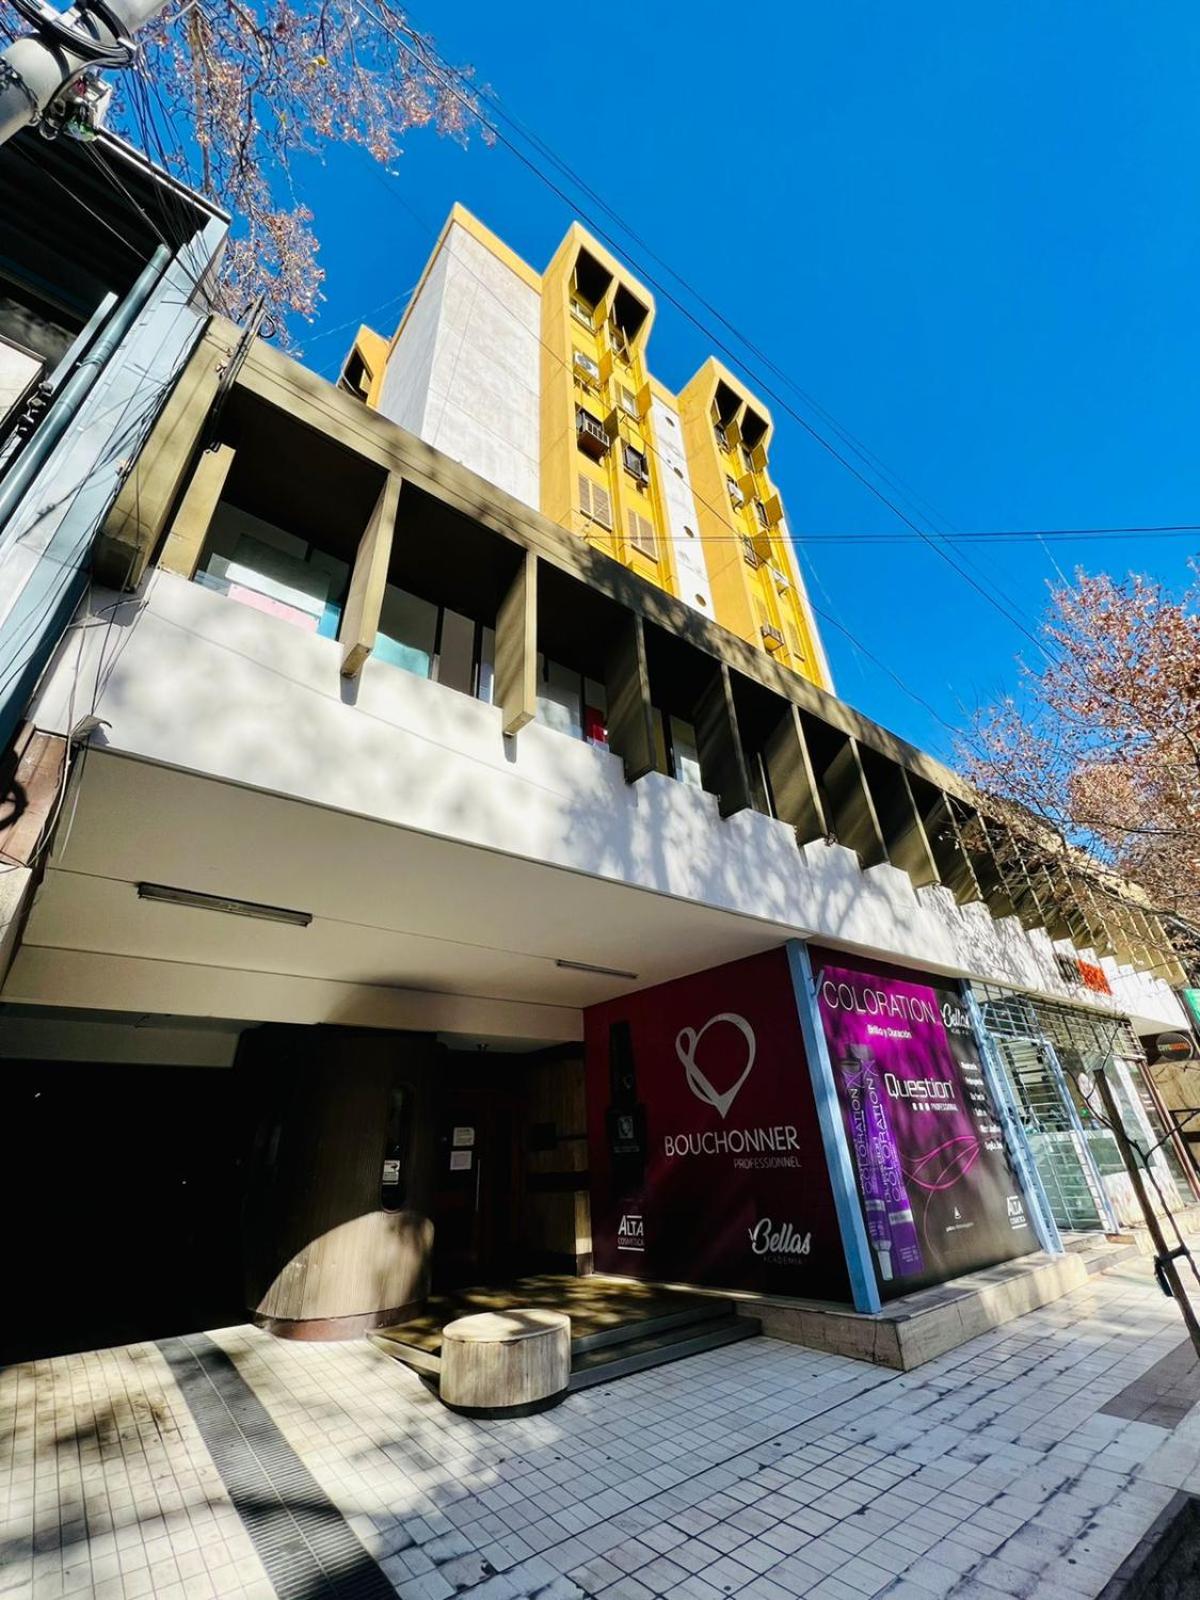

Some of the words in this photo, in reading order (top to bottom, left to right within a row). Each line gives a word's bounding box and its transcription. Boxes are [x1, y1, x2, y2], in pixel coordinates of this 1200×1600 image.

[823, 980, 936, 1024] COLORATION
[884, 1072, 955, 1100] Question
[664, 1125, 800, 1156] BOUCHONNER
[865, 1077, 903, 1203] COLORATION
[733, 1155, 802, 1169] PROFESSIONNEL
[618, 1214, 645, 1237] ALTA
[748, 1218, 811, 1255] Bellas
